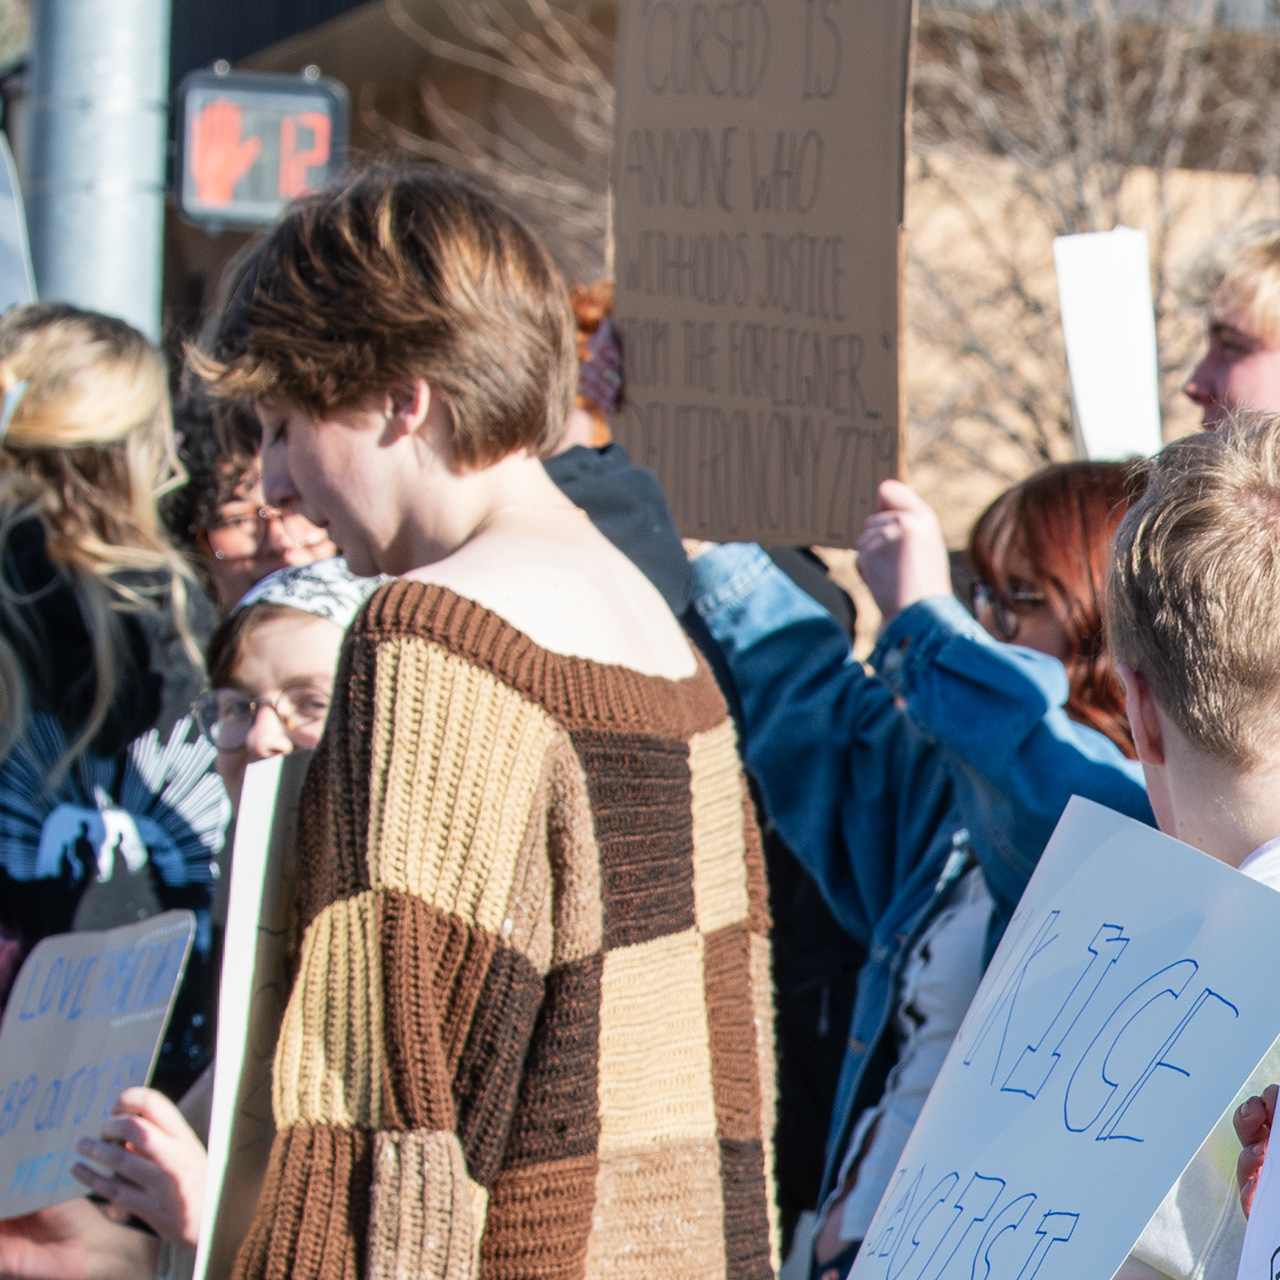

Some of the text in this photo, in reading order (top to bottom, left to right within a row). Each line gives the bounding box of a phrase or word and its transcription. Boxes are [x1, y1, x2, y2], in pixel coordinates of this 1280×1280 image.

[624, 126, 825, 214] ANYONE WHO
[681, 318, 718, 393] THE
[1000, 922, 1240, 1143] ICE
